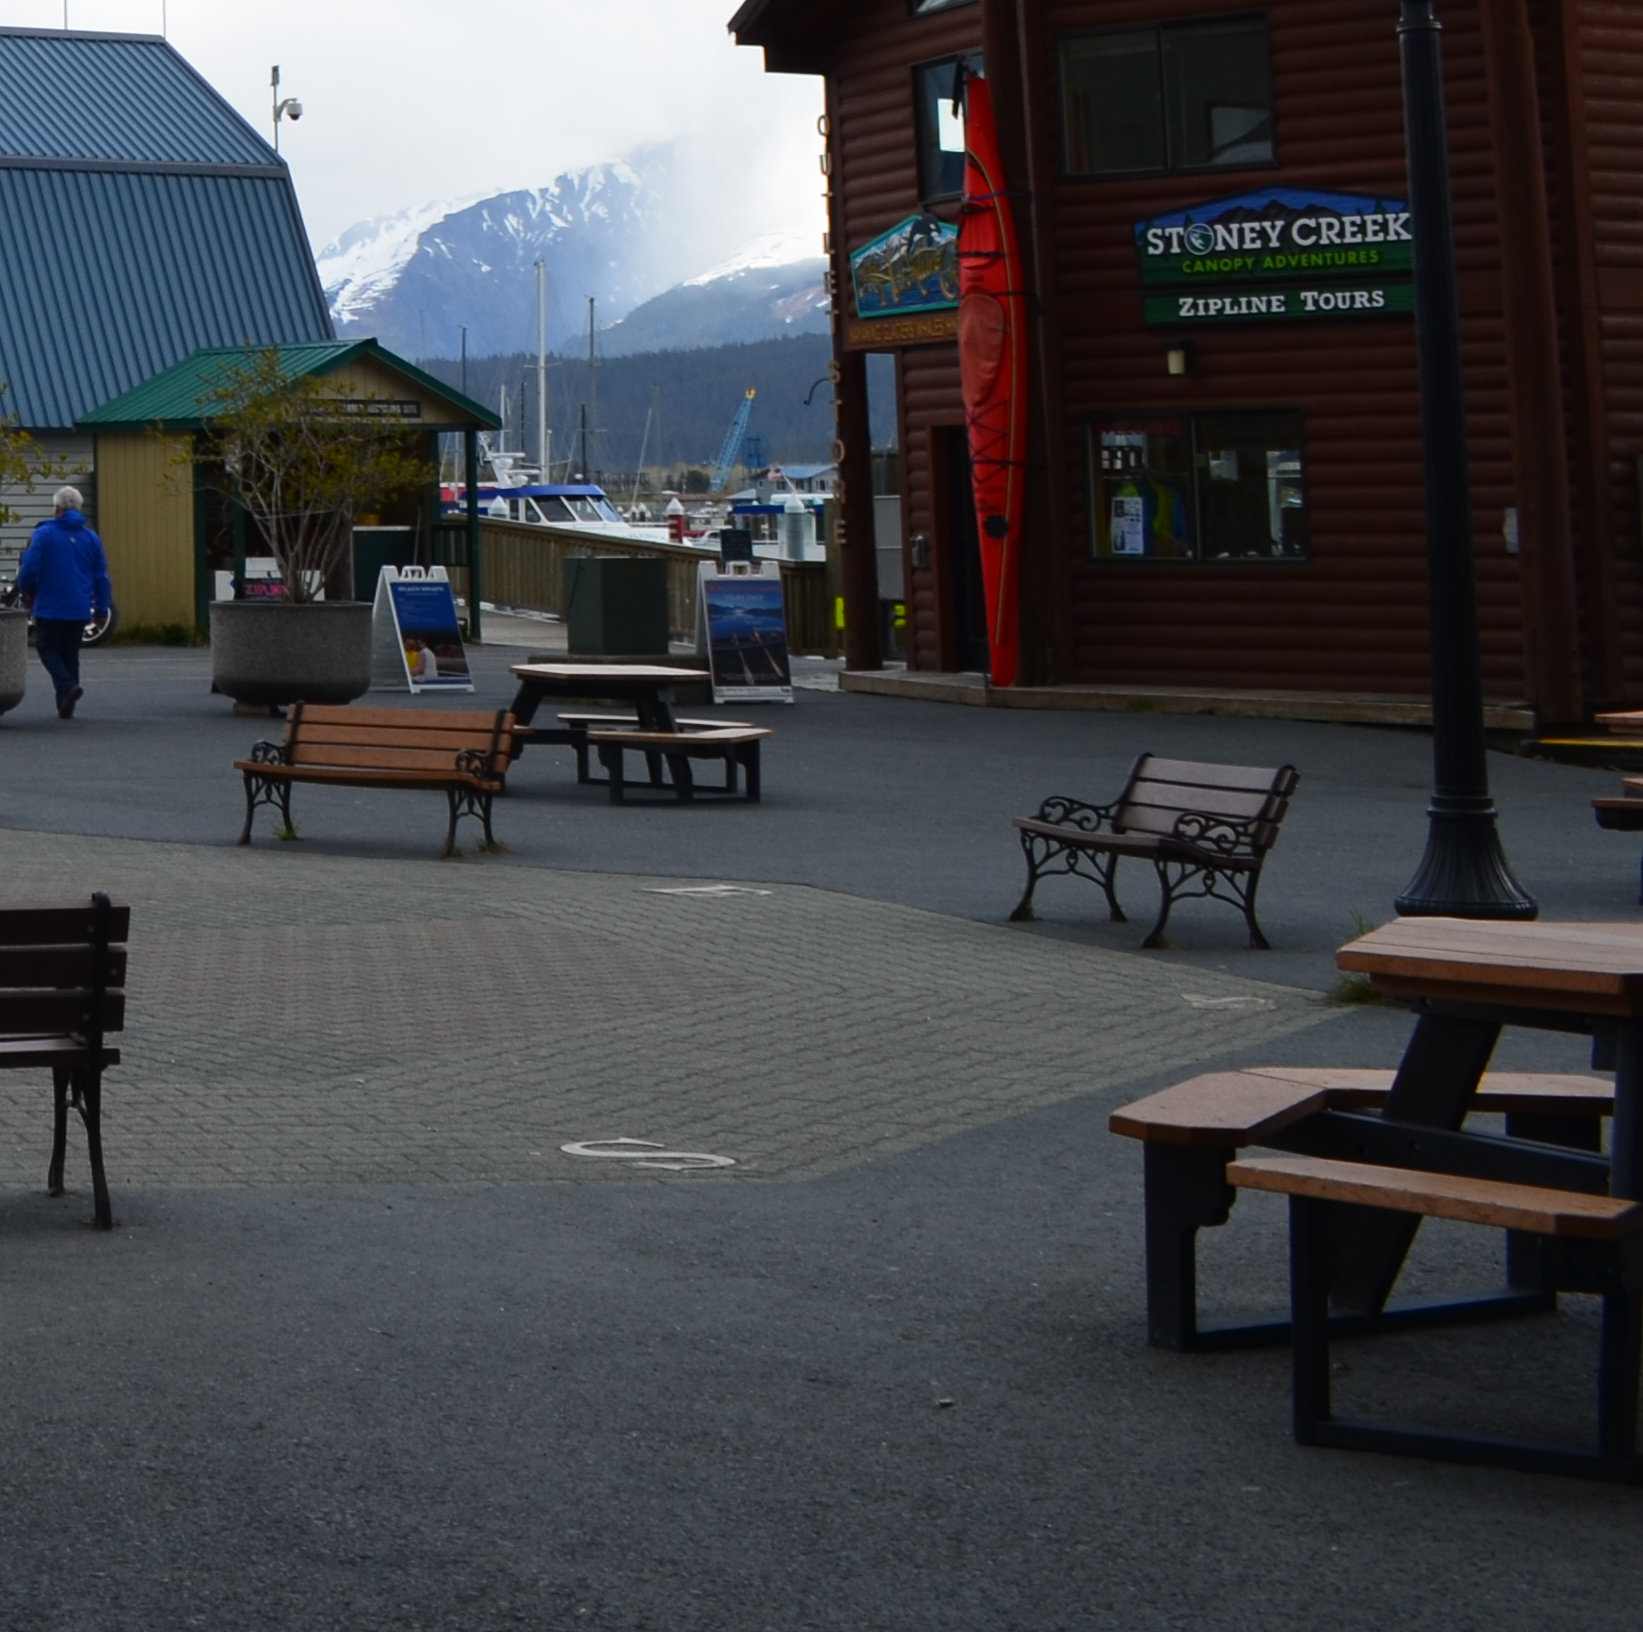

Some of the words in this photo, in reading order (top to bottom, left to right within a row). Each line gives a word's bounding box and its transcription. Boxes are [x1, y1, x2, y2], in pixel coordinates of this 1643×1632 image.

[1147, 220, 1285, 256] STONEY
[1291, 213, 1413, 246] CREEK
[1182, 257, 1255, 273] CANOPY
[1263, 250, 1380, 270] ADVENTURES
[827, 360, 847, 544] STORE
